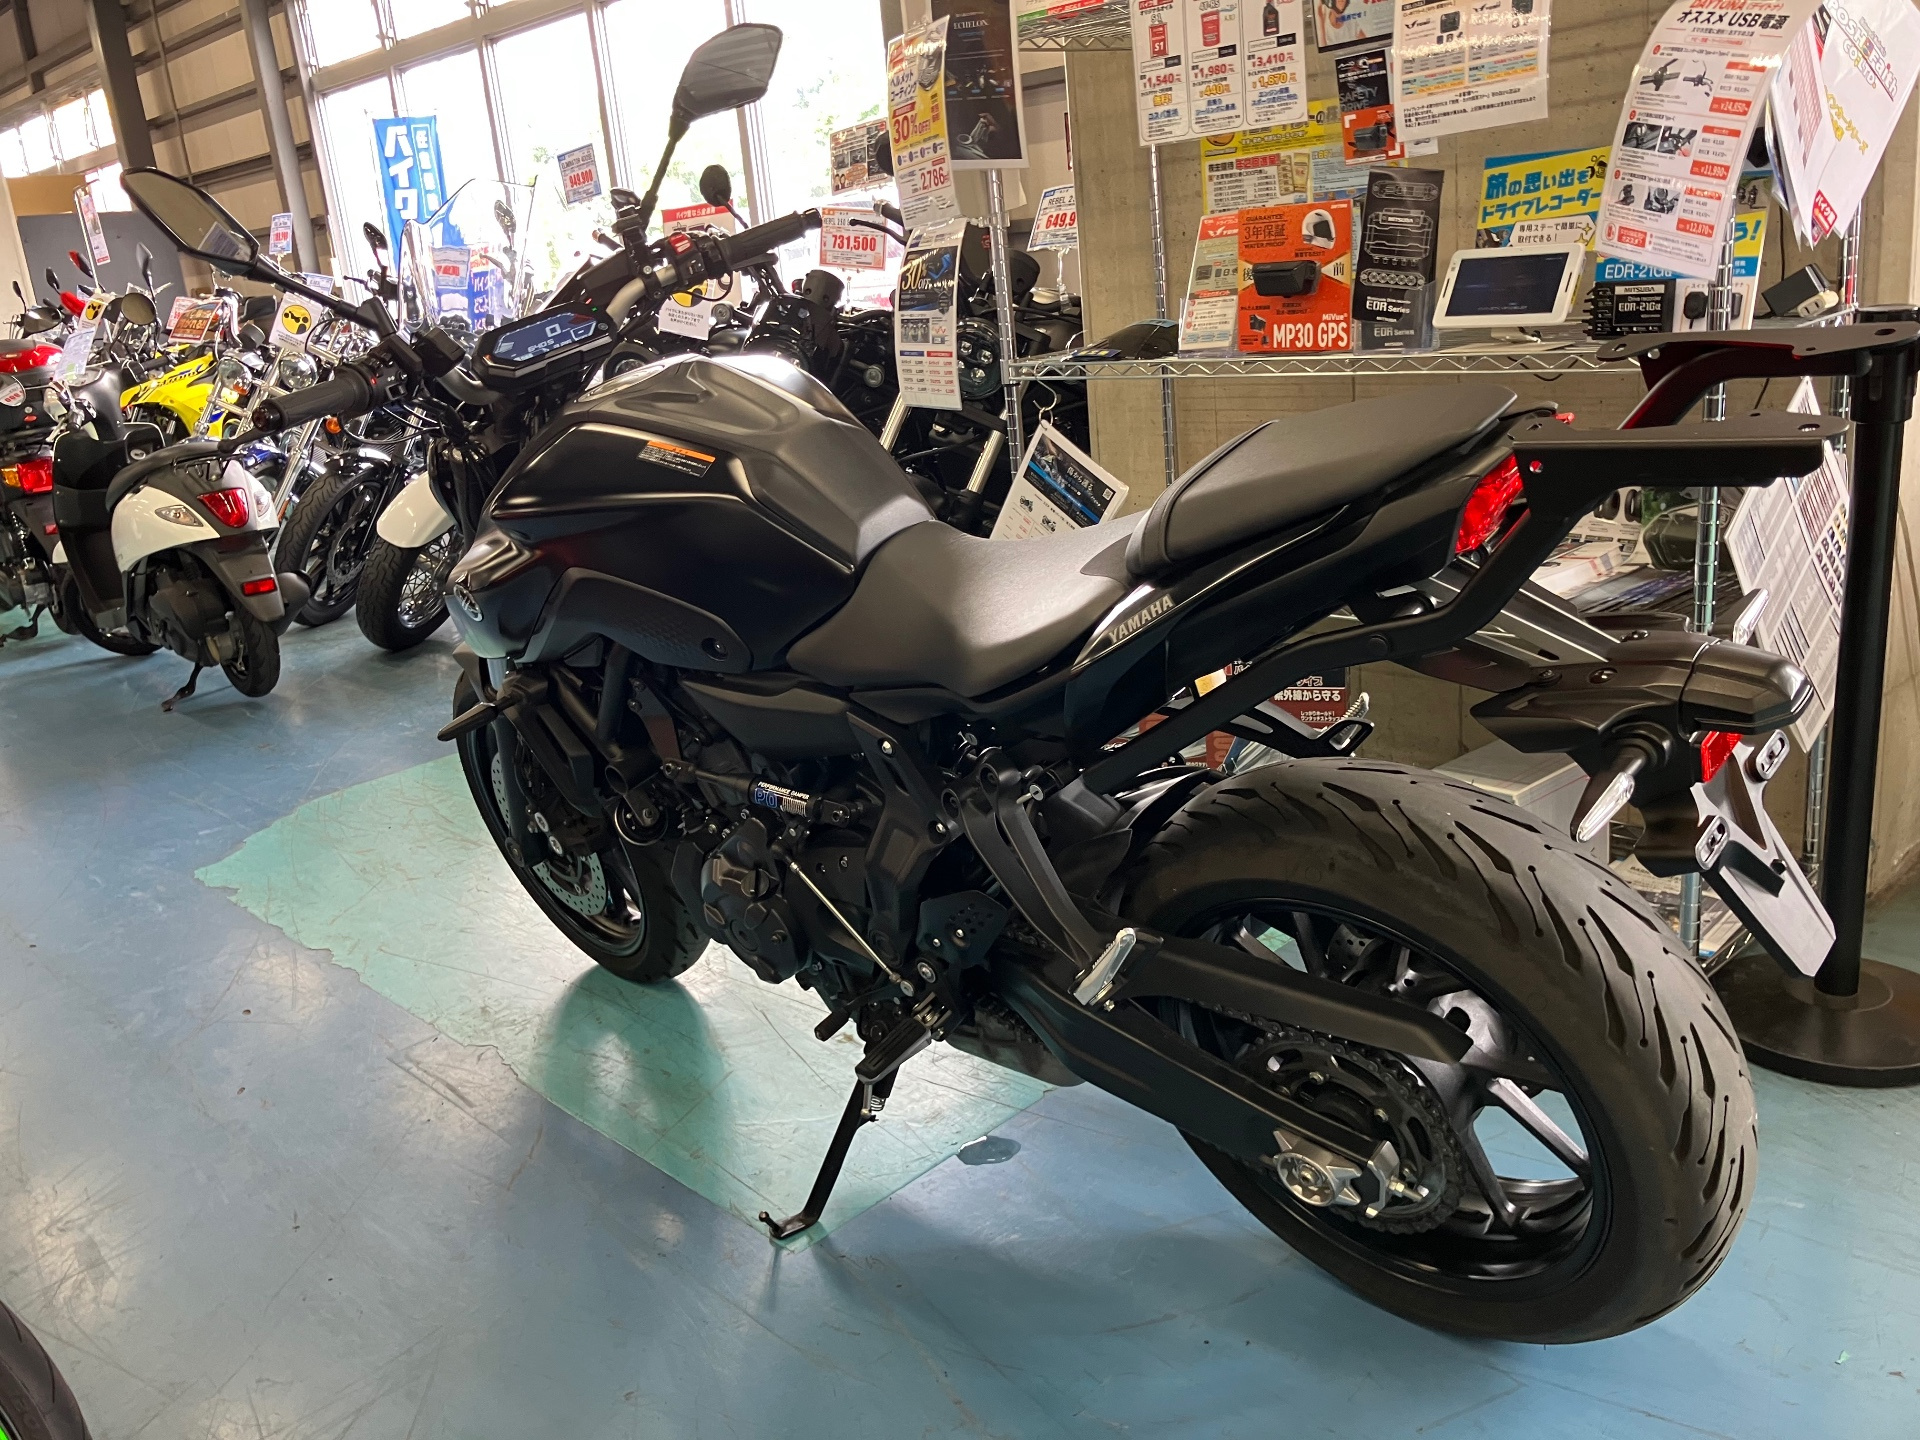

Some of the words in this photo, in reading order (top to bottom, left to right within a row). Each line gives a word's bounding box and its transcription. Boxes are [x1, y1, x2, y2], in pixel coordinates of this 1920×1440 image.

[1677, 10, 1724, 24] オススメ
[1728, 13, 1790, 30] USB電源
[1154, 42, 1164, 51] S1
[385, 125, 418, 219] バイク
[920, 166, 945, 191] 2,786
[1485, 168, 1591, 201] 旅の思い出を
[1481, 187, 1602, 223] ドライブレコーダー
[1245, 213, 1284, 222] GUARANTEE
[1244, 223, 1286, 240] 3年保証
[1519, 221, 1584, 232] 専用ステーで簡単に
[832, 235, 877, 251] 731,500
[1517, 234, 1558, 243] 取付できる!
[1366, 301, 1387, 312] EDR
[1388, 306, 1410, 314] Series
[1619, 301, 1662, 311] EDR-21Gα
[1273, 323, 1314, 348] MP30
[1317, 322, 1348, 348] GPS
[1374, 326, 1394, 337] EDR
[1109, 594, 1174, 644] YAMAHA
[758, 781, 791, 794] PERFORMANCE
[791, 790, 810, 799] DAMPER
